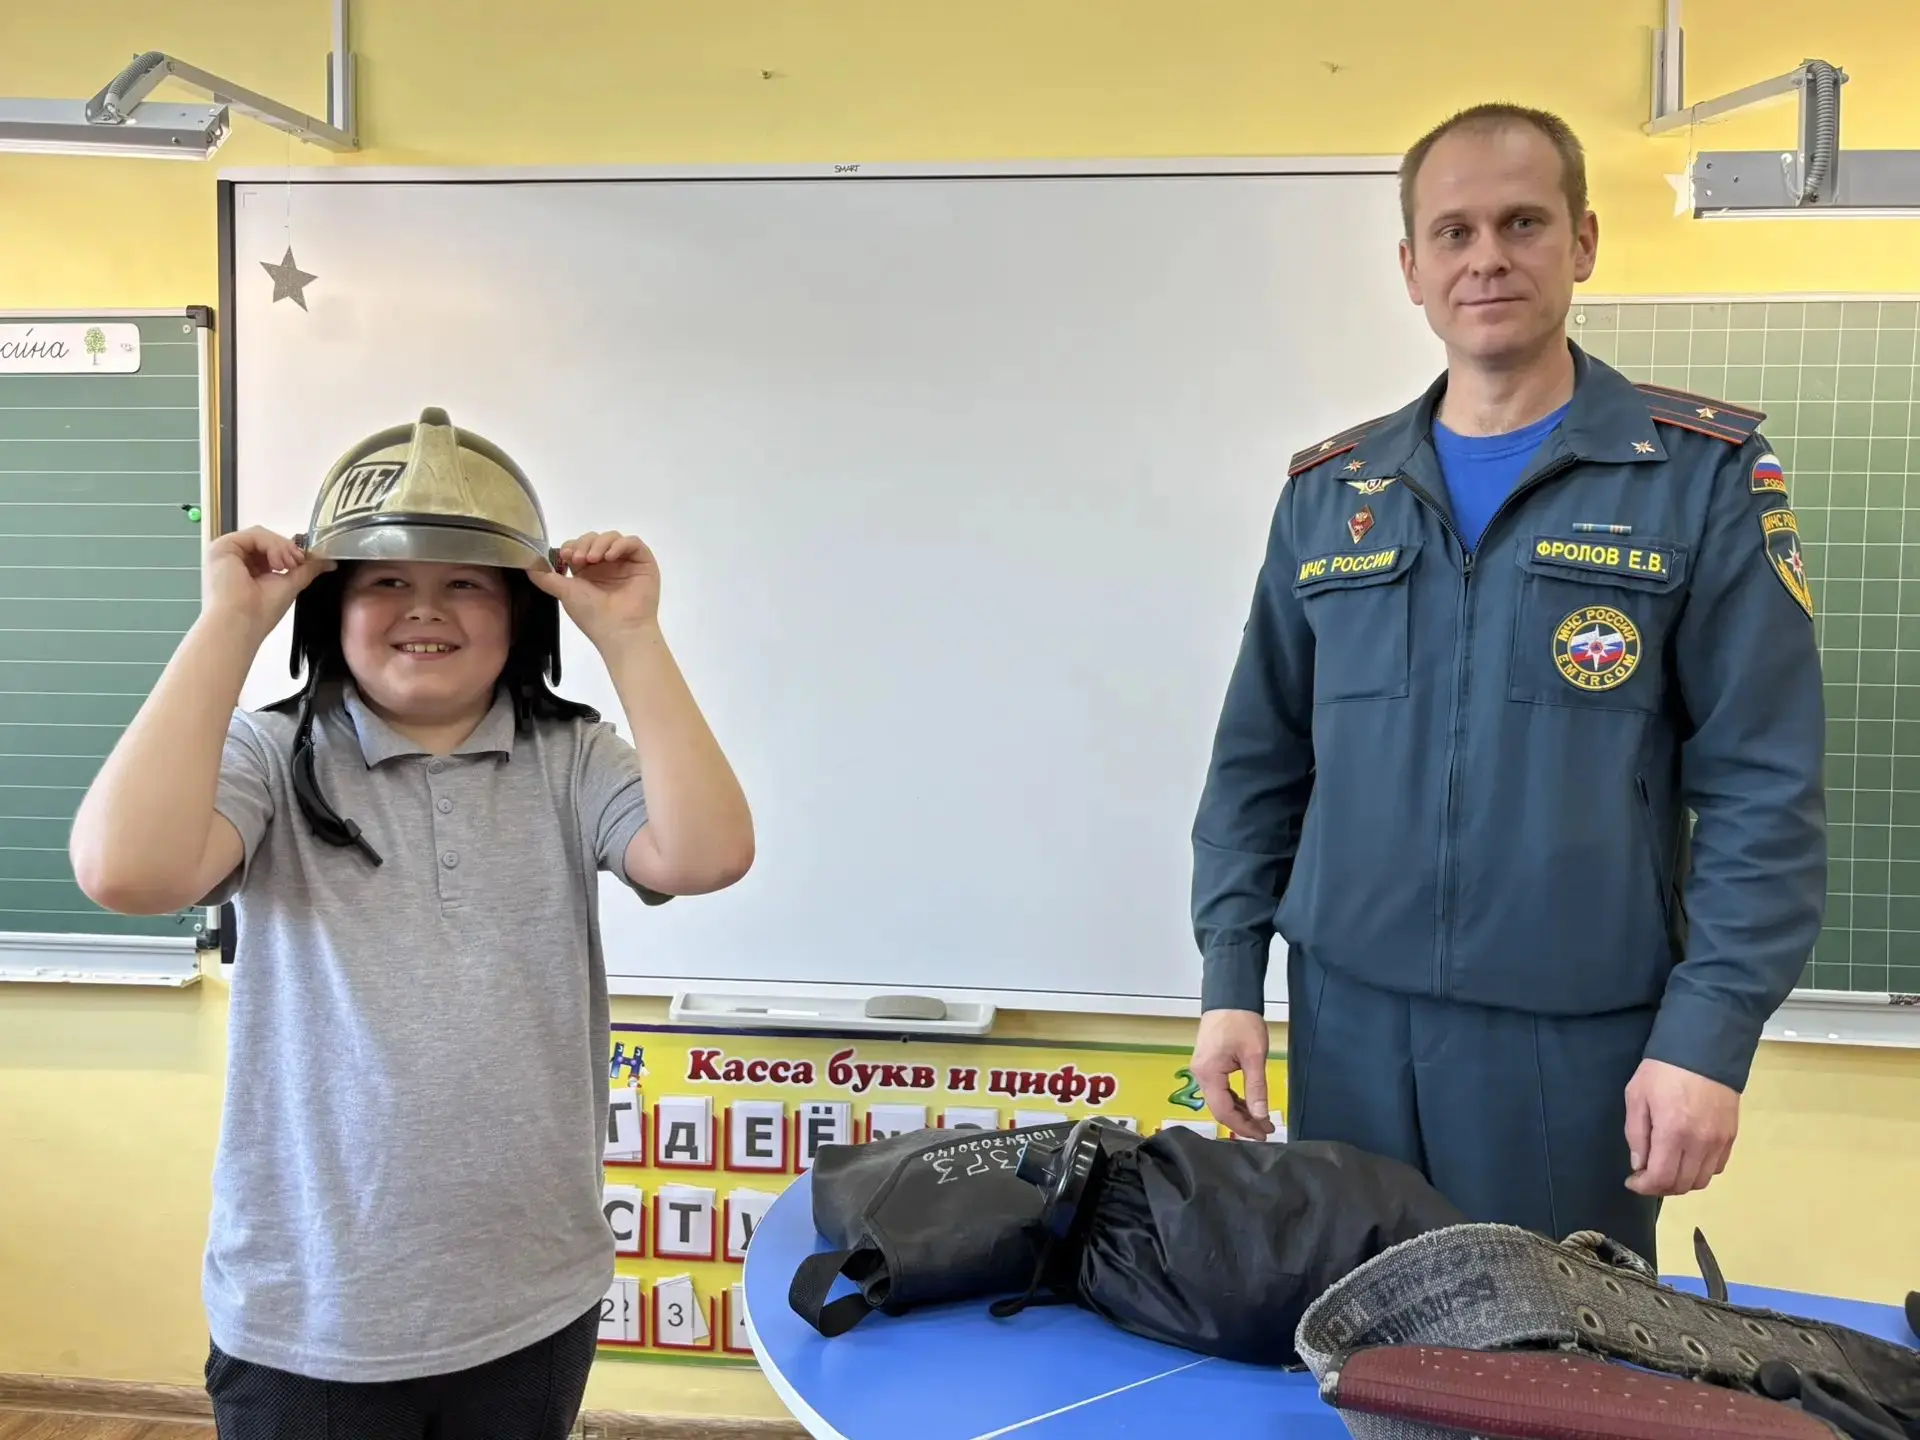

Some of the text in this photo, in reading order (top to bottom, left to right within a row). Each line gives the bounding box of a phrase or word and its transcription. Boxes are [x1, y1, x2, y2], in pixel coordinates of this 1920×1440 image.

[834, 164, 860, 173] SMART
[341, 468, 397, 510] 117
[1764, 515, 1783, 531] МЧС
[1299, 549, 1396, 581] МЧС РОССИИ
[1536, 540, 1666, 574] ФРОЛОВ Е.В.
[1557, 609, 1637, 642] МЧС РОССИИ
[1557, 653, 1636, 686] EMERCOM
[687, 1048, 1116, 1105] Касса букв и цифр
[664, 1121, 698, 1160] Д
[746, 1116, 773, 1158] Е
[808, 1105, 836, 1158] Ё
[603, 1200, 635, 1241] С
[669, 1202, 702, 1243] Т
[600, 1298, 615, 1322] 2
[667, 1303, 684, 1327] 3
